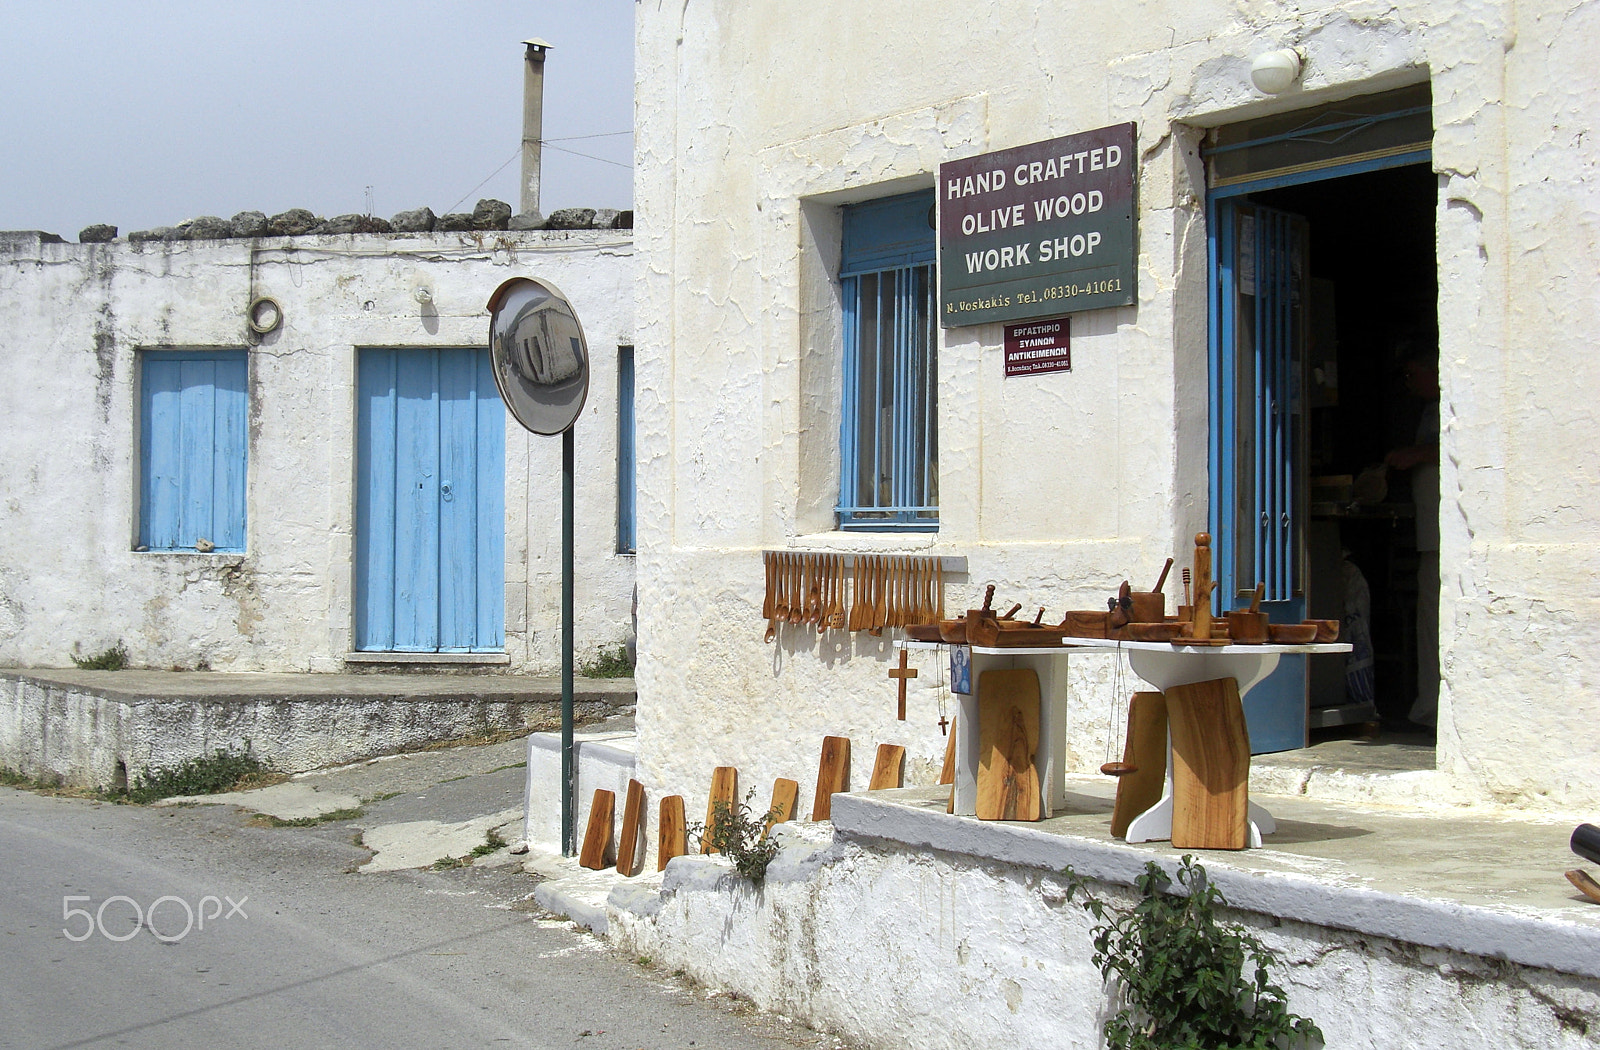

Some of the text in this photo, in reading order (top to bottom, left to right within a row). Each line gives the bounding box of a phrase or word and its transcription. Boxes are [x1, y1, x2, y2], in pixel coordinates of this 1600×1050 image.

[947, 145, 1122, 200] HAND CRAFTED
[961, 190, 1104, 236] OLIVE WOOD
[965, 231, 1102, 274] WORK SHOP
[946, 294, 1011, 314] N.Voskakis
[1013, 323, 1060, 337] ΕΡΓΑΣΤΗΡΙΟ
[1019, 336, 1055, 349] ΞΥΛΙΝΩΝ
[1008, 347, 1067, 361] ΑΝΤΙΚΕΙΜΕΝΩΝ
